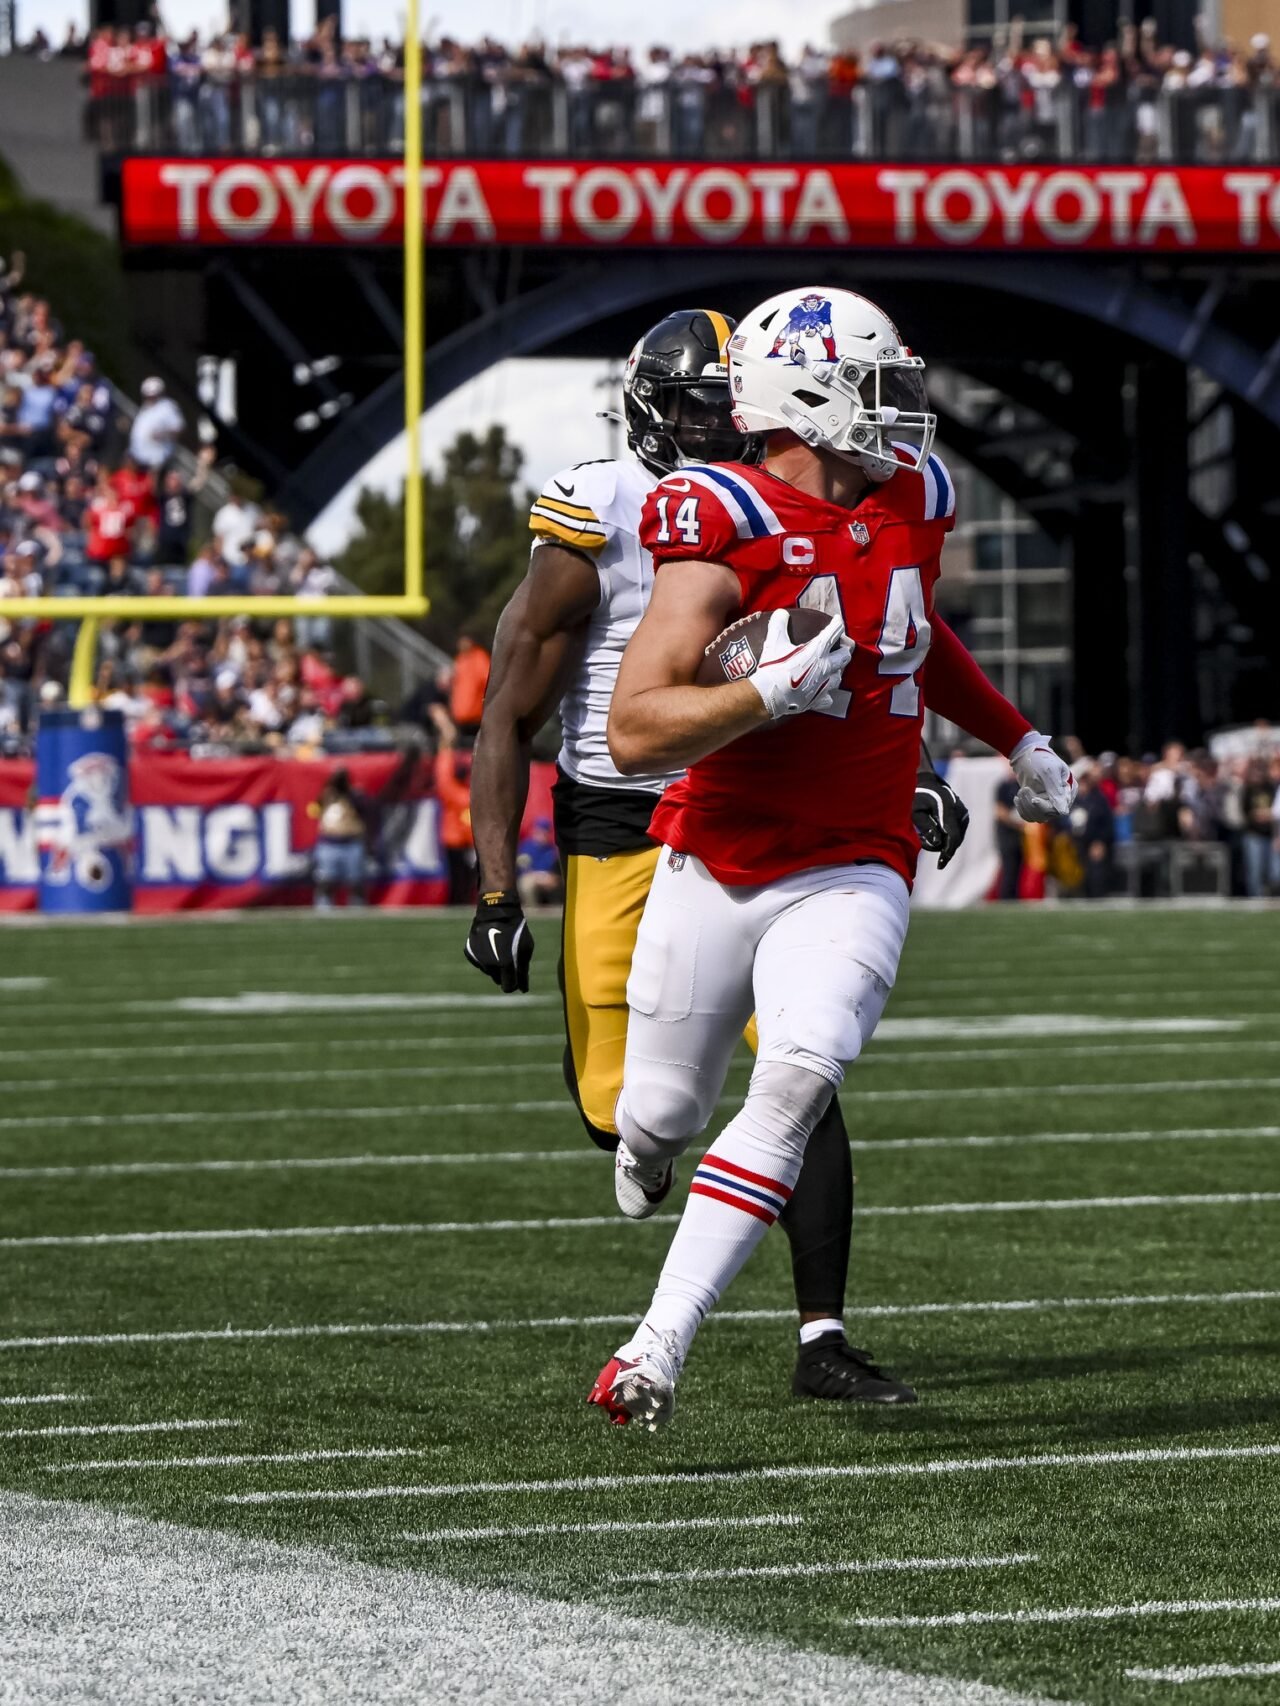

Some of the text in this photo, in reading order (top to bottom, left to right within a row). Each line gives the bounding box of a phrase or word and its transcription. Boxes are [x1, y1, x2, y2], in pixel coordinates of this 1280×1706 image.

[160, 163, 496, 242] TOYOTA
[523, 166, 850, 243] TOYOTA
[877, 169, 1198, 245] TOYOTA
[655, 496, 701, 544] 14
[782, 537, 815, 565] C
[726, 652, 753, 678] NFL
[797, 565, 932, 719] 14
